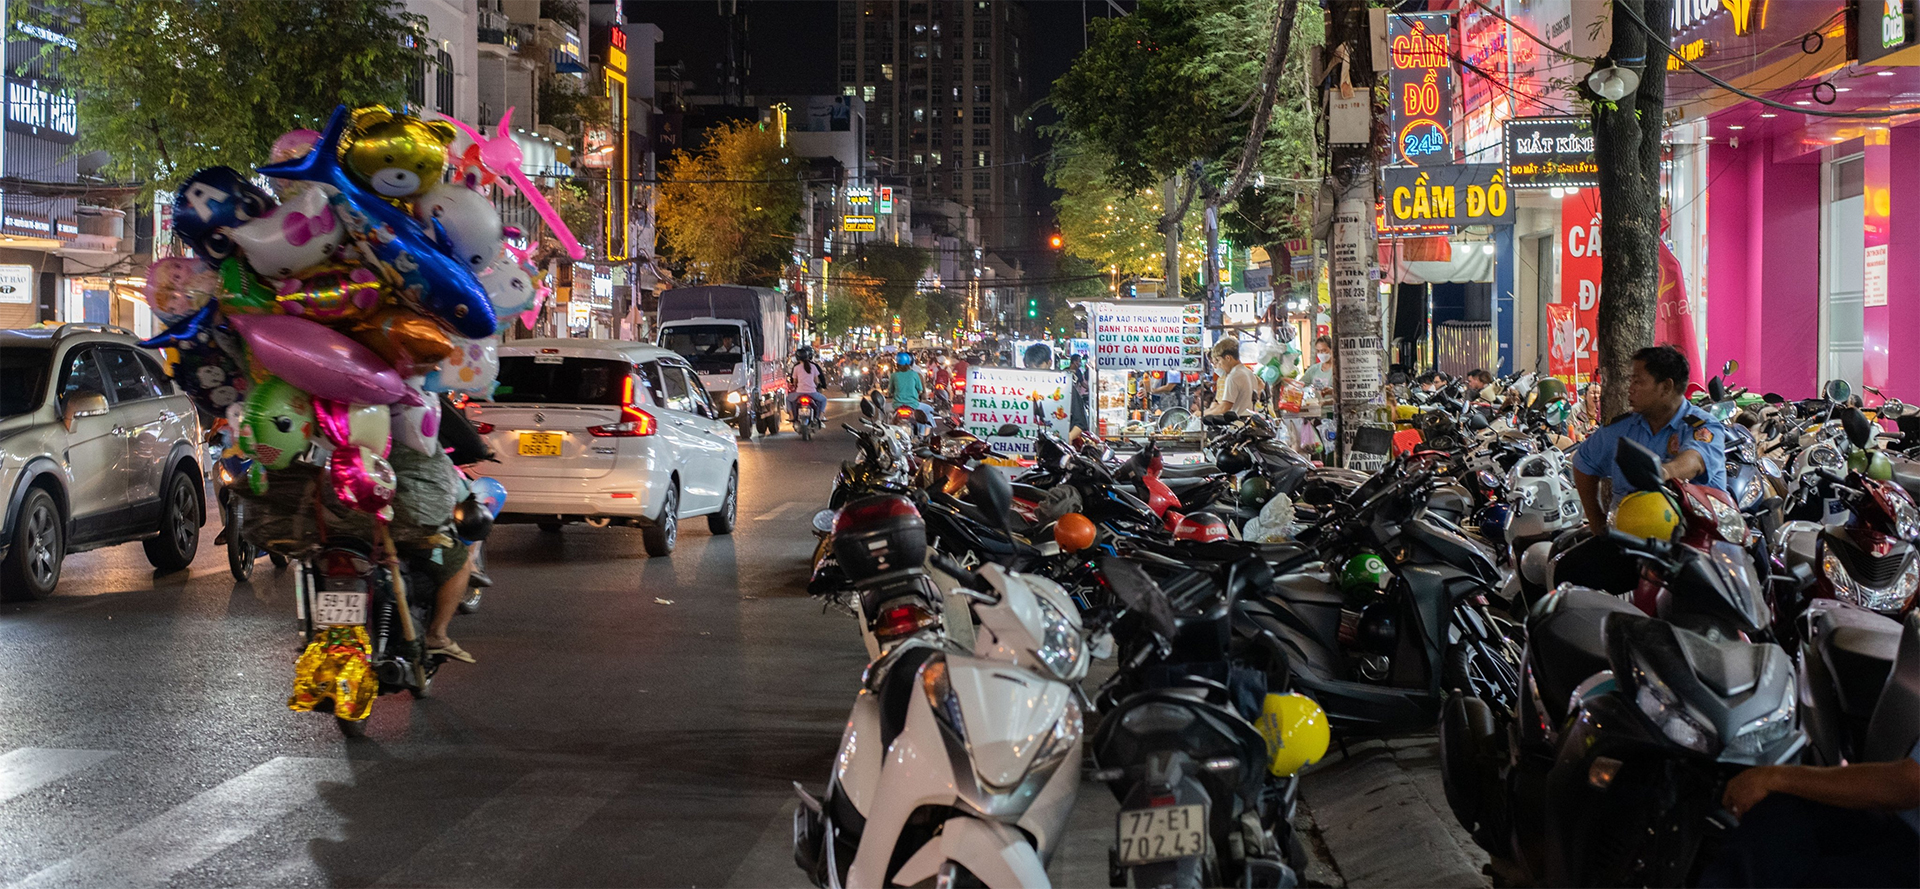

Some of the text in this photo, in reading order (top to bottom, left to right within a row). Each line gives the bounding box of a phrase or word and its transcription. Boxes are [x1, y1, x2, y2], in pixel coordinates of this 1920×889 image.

[1393, 21, 1448, 69] CẦM
[1404, 69, 1440, 116] ĐỒ
[10, 79, 77, 136] NHẬT HÀO
[660, 133, 676, 144] PNJ
[1404, 125, 1442, 155] 24h
[1392, 169, 1508, 220] CẦM ĐỒ
[1568, 211, 1602, 258] CẦ
[1229, 300, 1249, 313] mi
[1578, 279, 1602, 311] Đ
[1098, 343, 1120, 356] HỘT
[1124, 343, 1138, 354] GÀ
[1358, 338, 1376, 349] VAY
[1576, 327, 1599, 359] 2
[1098, 355, 1116, 366] CÚT
[1118, 355, 1136, 367] LỘN
[1146, 357, 1160, 368] VỊT
[1163, 356, 1180, 368] LỘN
[970, 411, 998, 423] TRÀ
[971, 397, 1029, 410] TRÀ ĐÀO
[993, 441, 1029, 453] CHANH
[1131, 808, 1189, 835] 77-E1
[1122, 832, 1202, 861] 702.43
